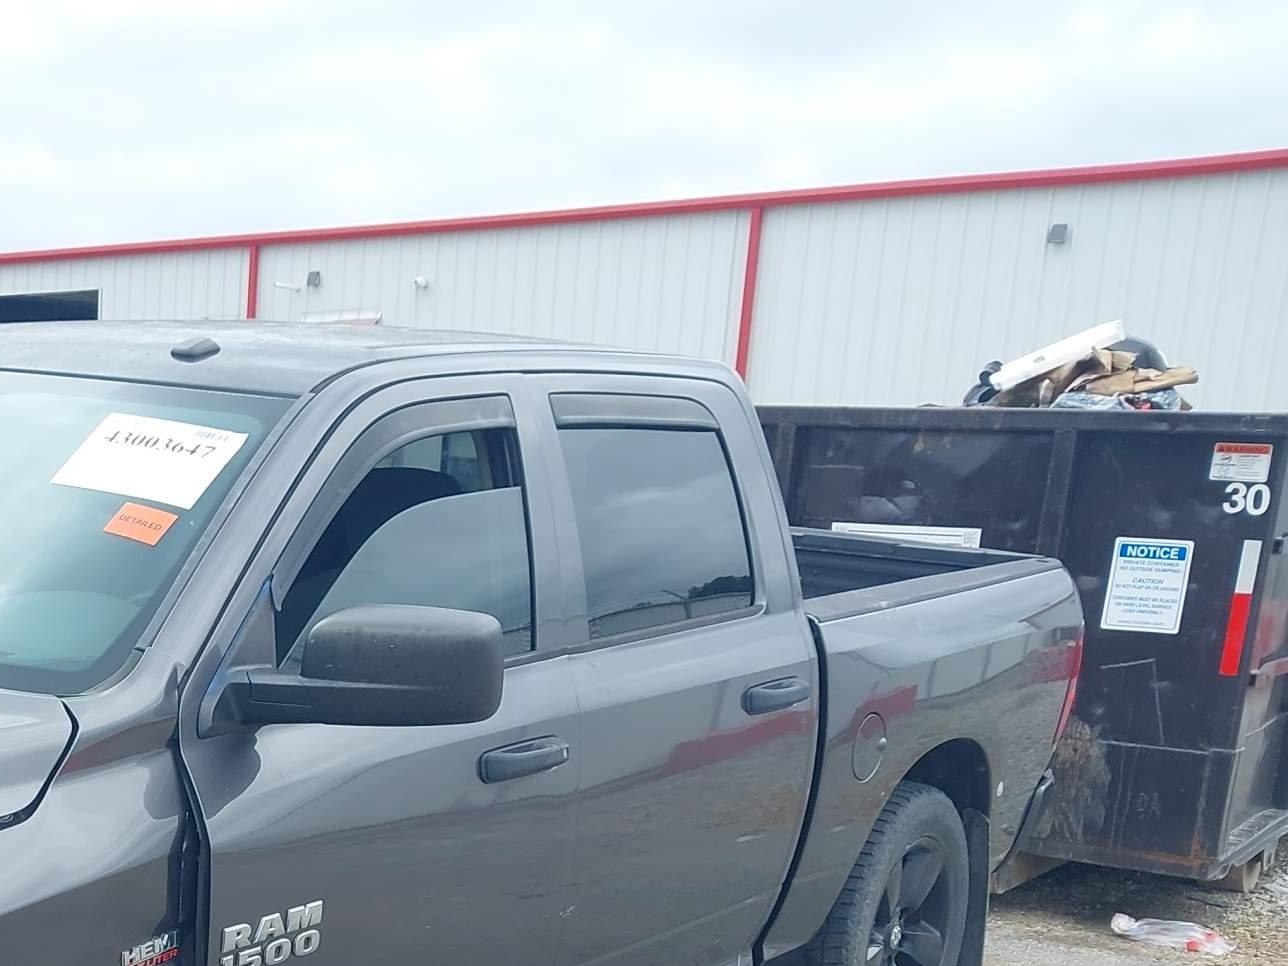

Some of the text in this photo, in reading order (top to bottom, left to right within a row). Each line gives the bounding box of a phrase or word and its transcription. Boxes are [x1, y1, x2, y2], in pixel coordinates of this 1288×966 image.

[103, 430, 217, 459] 43003647
[1222, 482, 1271, 516] 30
[119, 513, 163, 532] DETAILED
[1126, 545, 1180, 559] NOTICE
[221, 899, 324, 953] RAM
